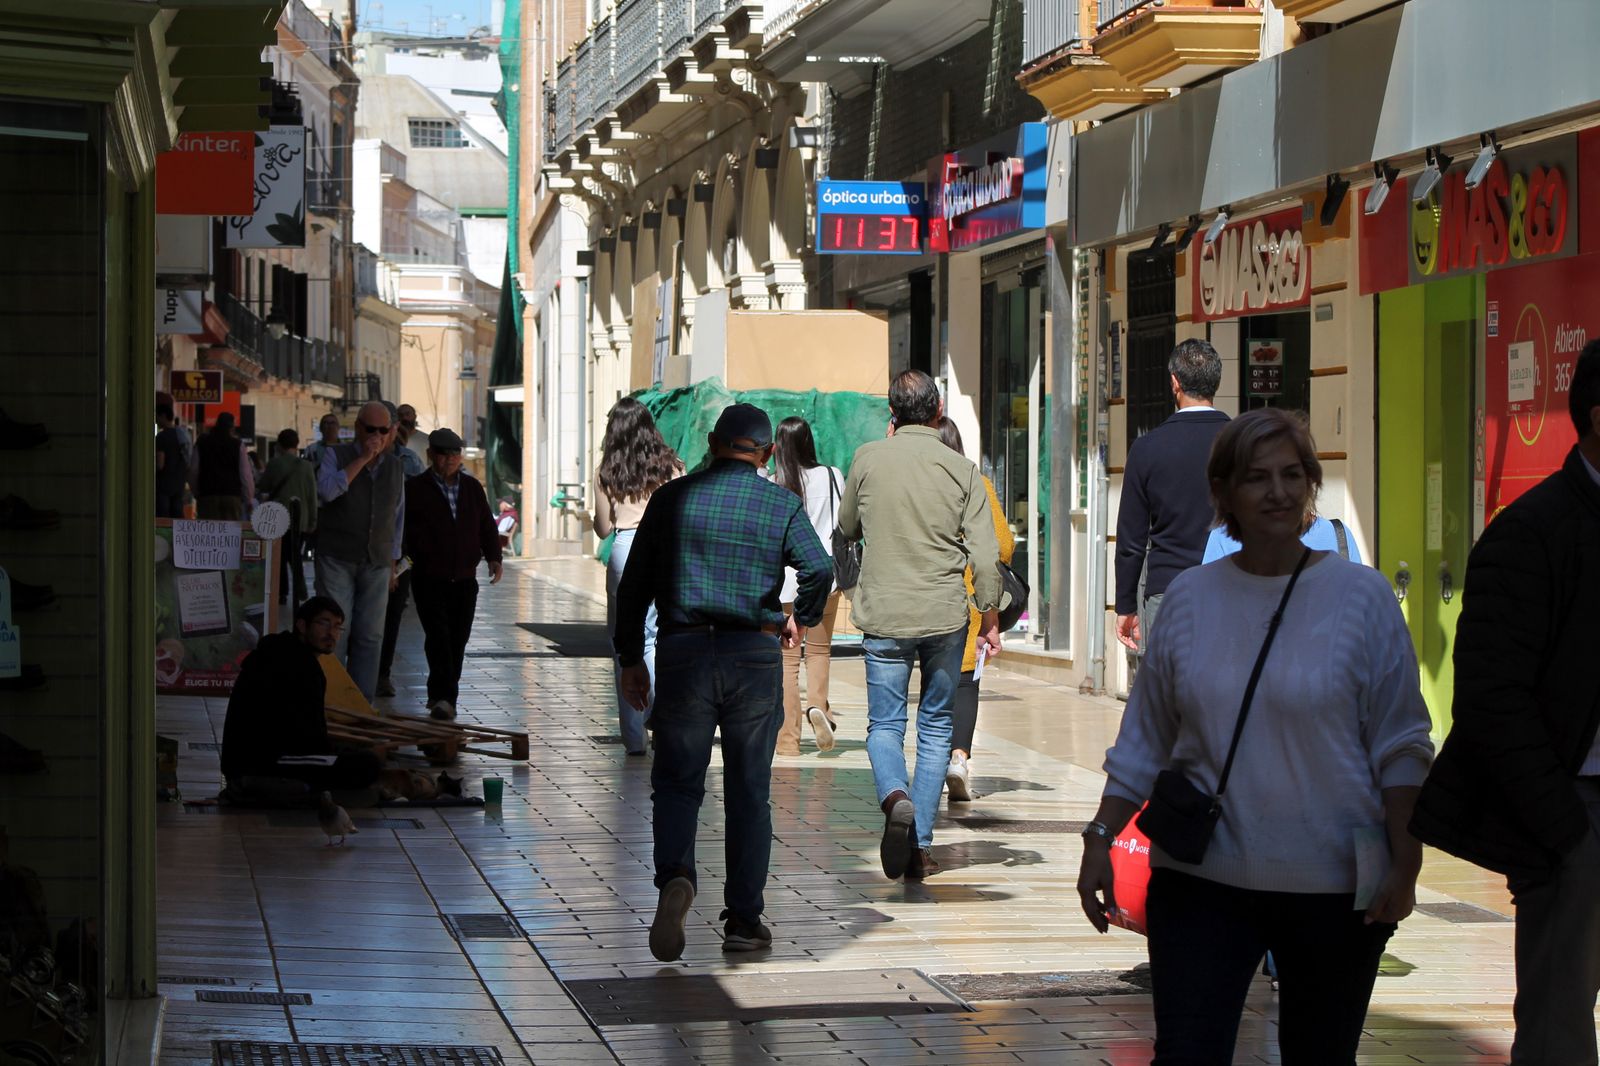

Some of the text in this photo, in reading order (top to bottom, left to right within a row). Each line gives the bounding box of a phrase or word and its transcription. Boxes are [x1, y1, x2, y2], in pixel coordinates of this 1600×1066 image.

[975, 156, 1013, 207] urbano
[822, 187, 920, 206] óptica urbano
[1553, 323, 1586, 353] Abierto
[1553, 362, 1572, 393] 365
[173, 389, 219, 401] TABACOS
[210, 679, 222, 687] TU
